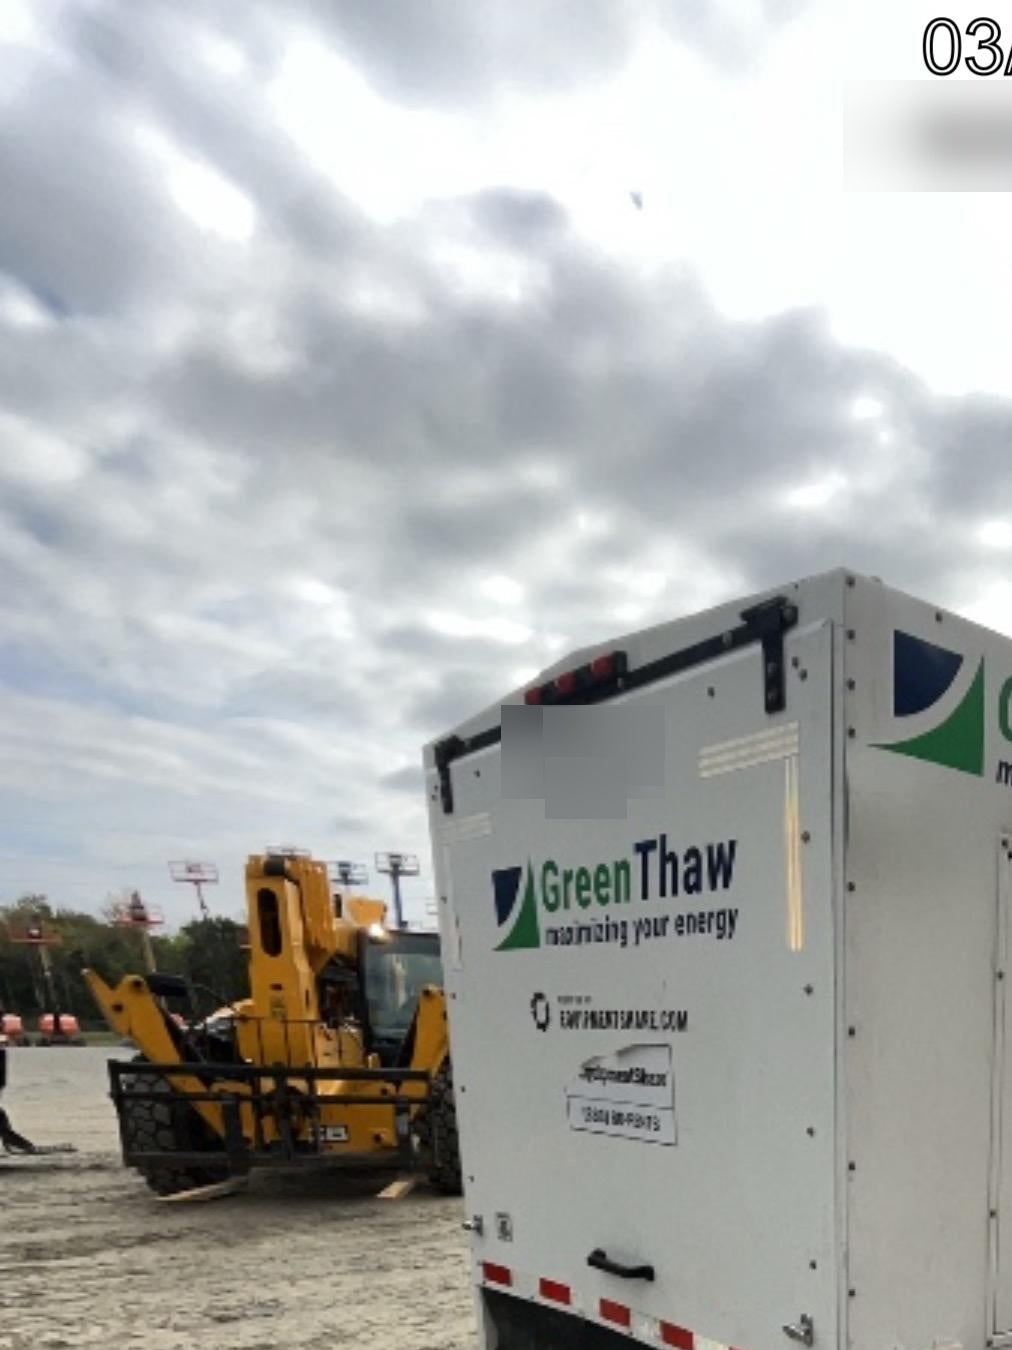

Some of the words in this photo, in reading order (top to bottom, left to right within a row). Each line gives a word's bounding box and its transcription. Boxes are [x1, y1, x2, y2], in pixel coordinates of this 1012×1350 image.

[541, 834, 737, 912] GreenThaw
[545, 915, 627, 947] maximizing
[633, 914, 670, 947] your
[674, 908, 739, 940] energy
